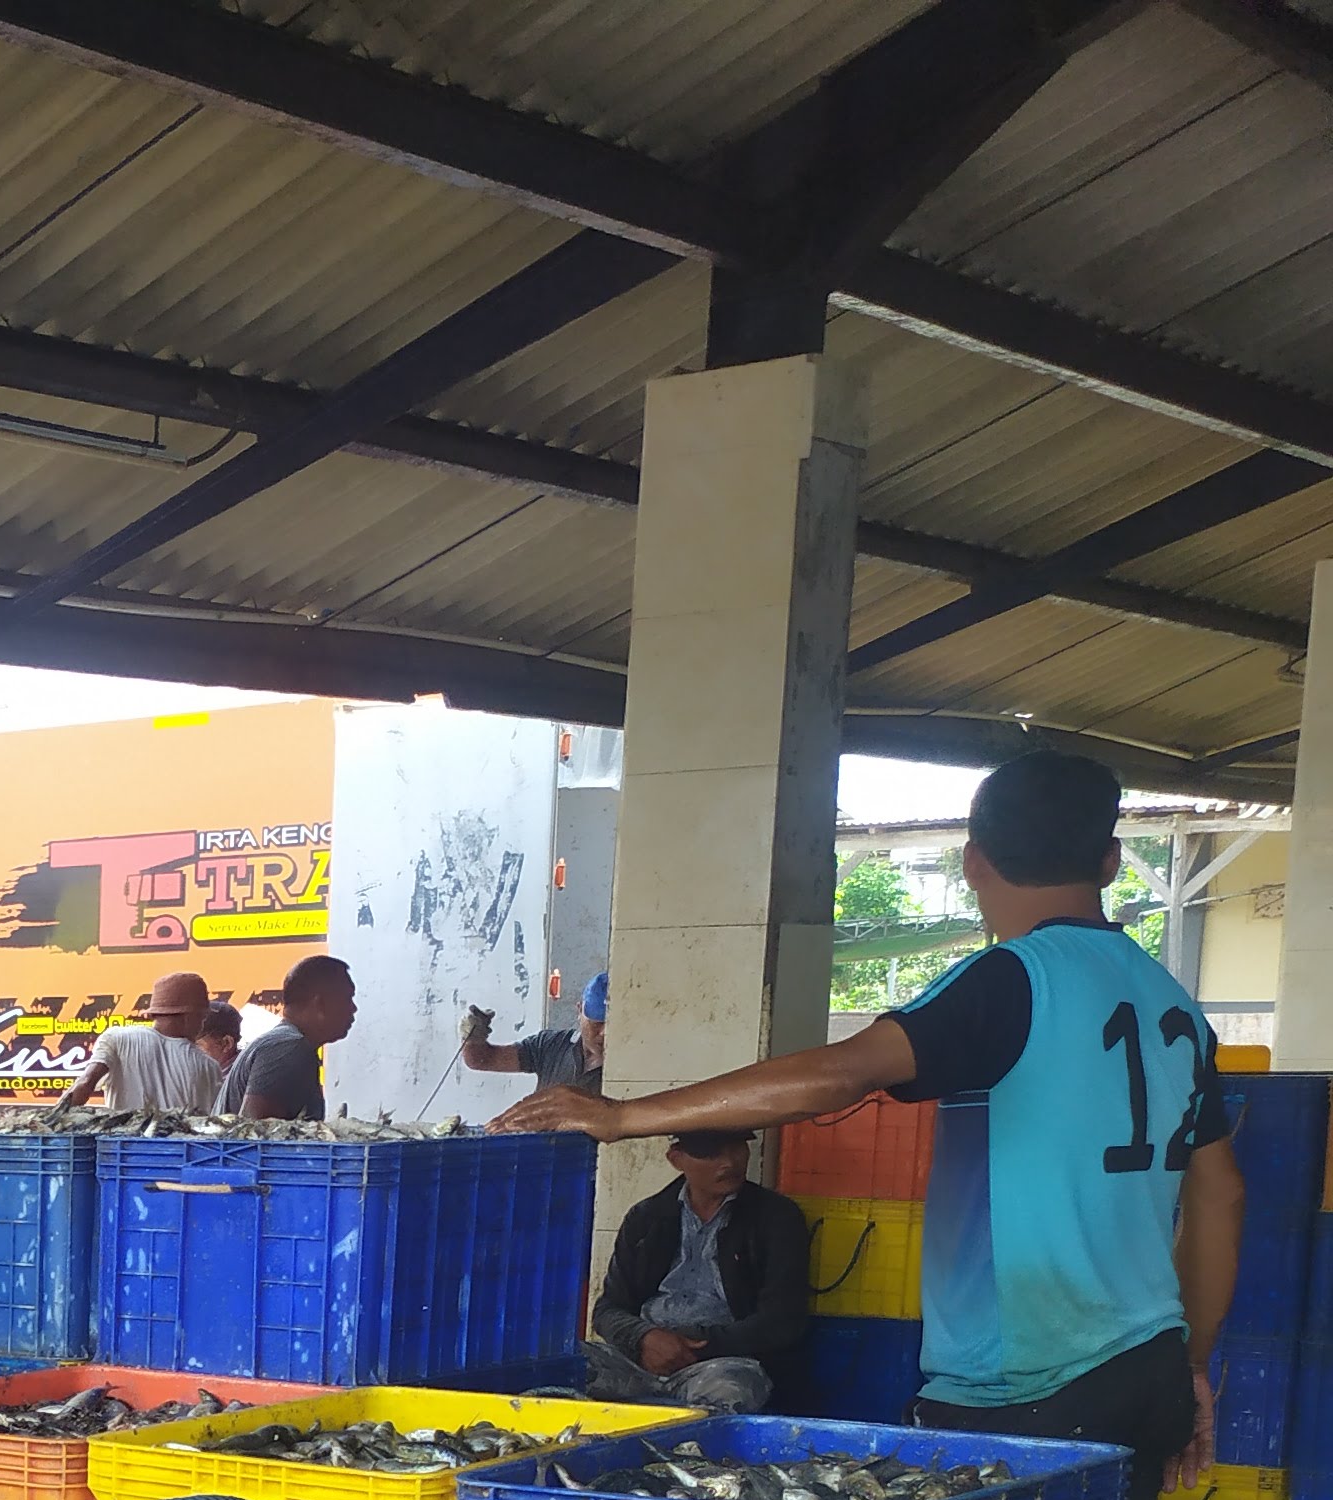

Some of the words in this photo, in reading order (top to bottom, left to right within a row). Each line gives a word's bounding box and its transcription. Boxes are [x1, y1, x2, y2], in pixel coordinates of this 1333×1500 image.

[198, 829, 258, 850] IRTA
[197, 850, 331, 910] TRA
[208, 923, 252, 933] Service
[255, 919, 290, 931] Make
[293, 917, 322, 929] This
[54, 1017, 95, 1034] twitter
[1103, 1001, 1205, 1173] 12
